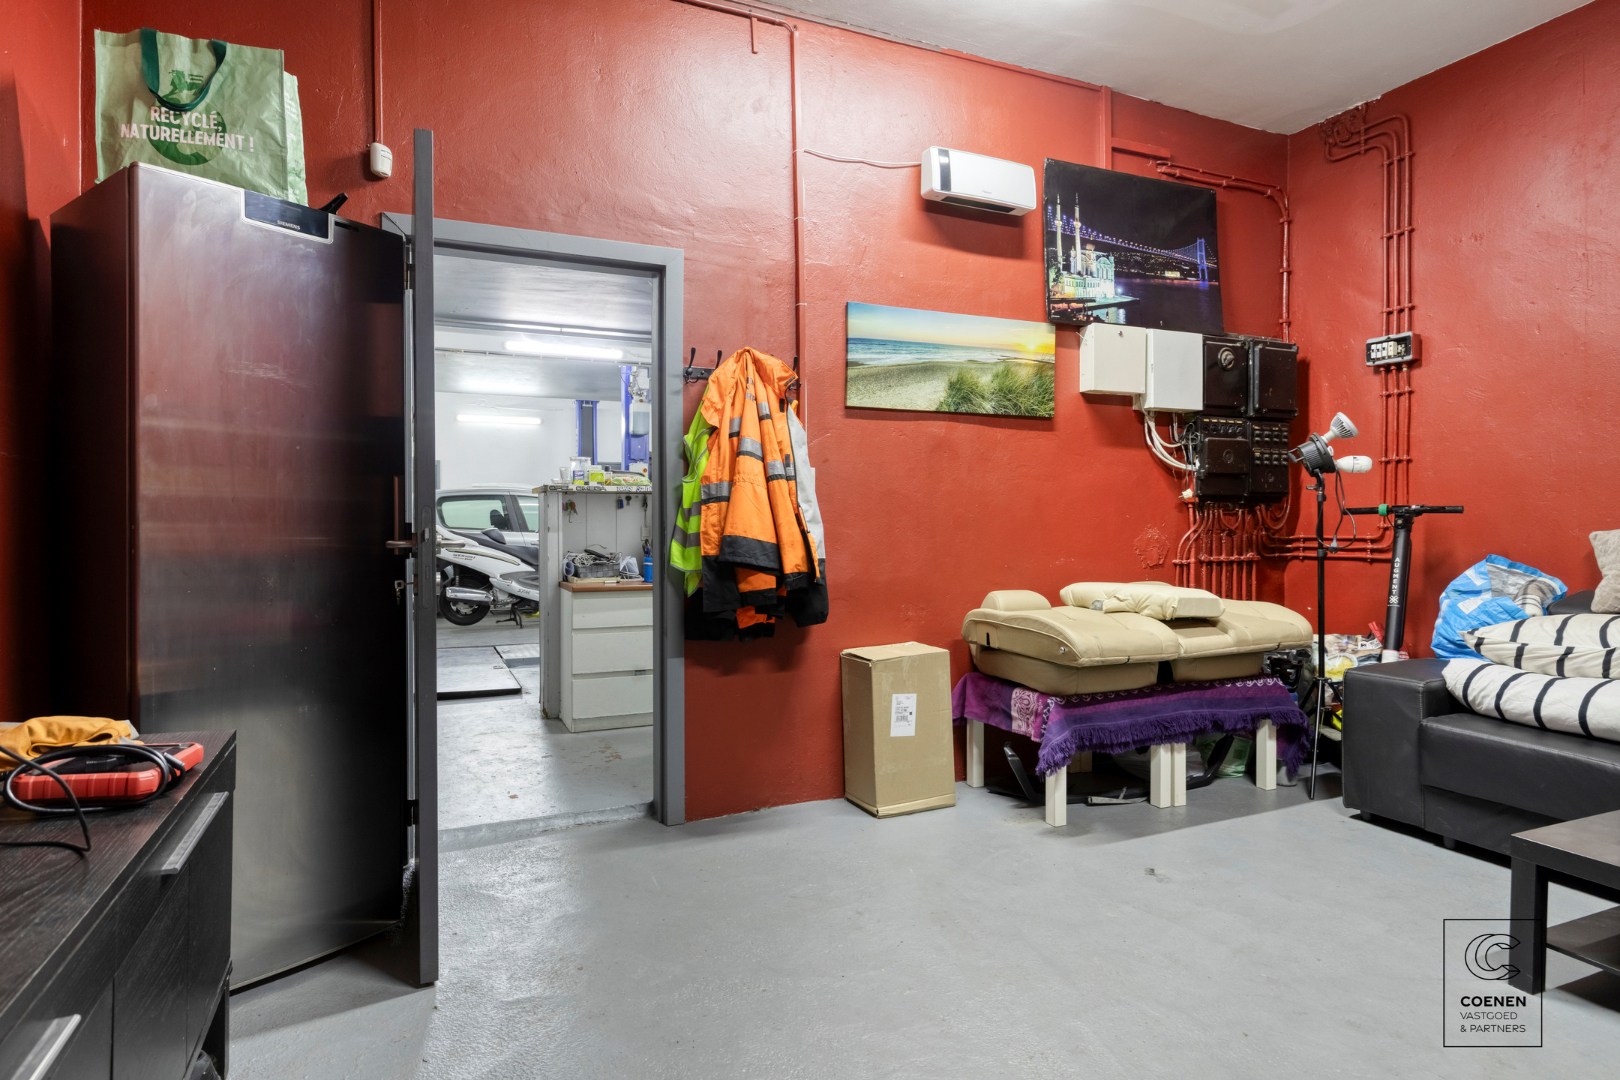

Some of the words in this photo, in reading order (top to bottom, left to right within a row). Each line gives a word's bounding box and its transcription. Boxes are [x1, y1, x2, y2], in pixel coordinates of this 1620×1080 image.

[151, 106, 223, 132] RECYCLÉ,
[121, 124, 245, 150] NATURELLEMENT
[277, 220, 301, 230] SIEMENS
[1391, 557, 1401, 595] AUGMENT
